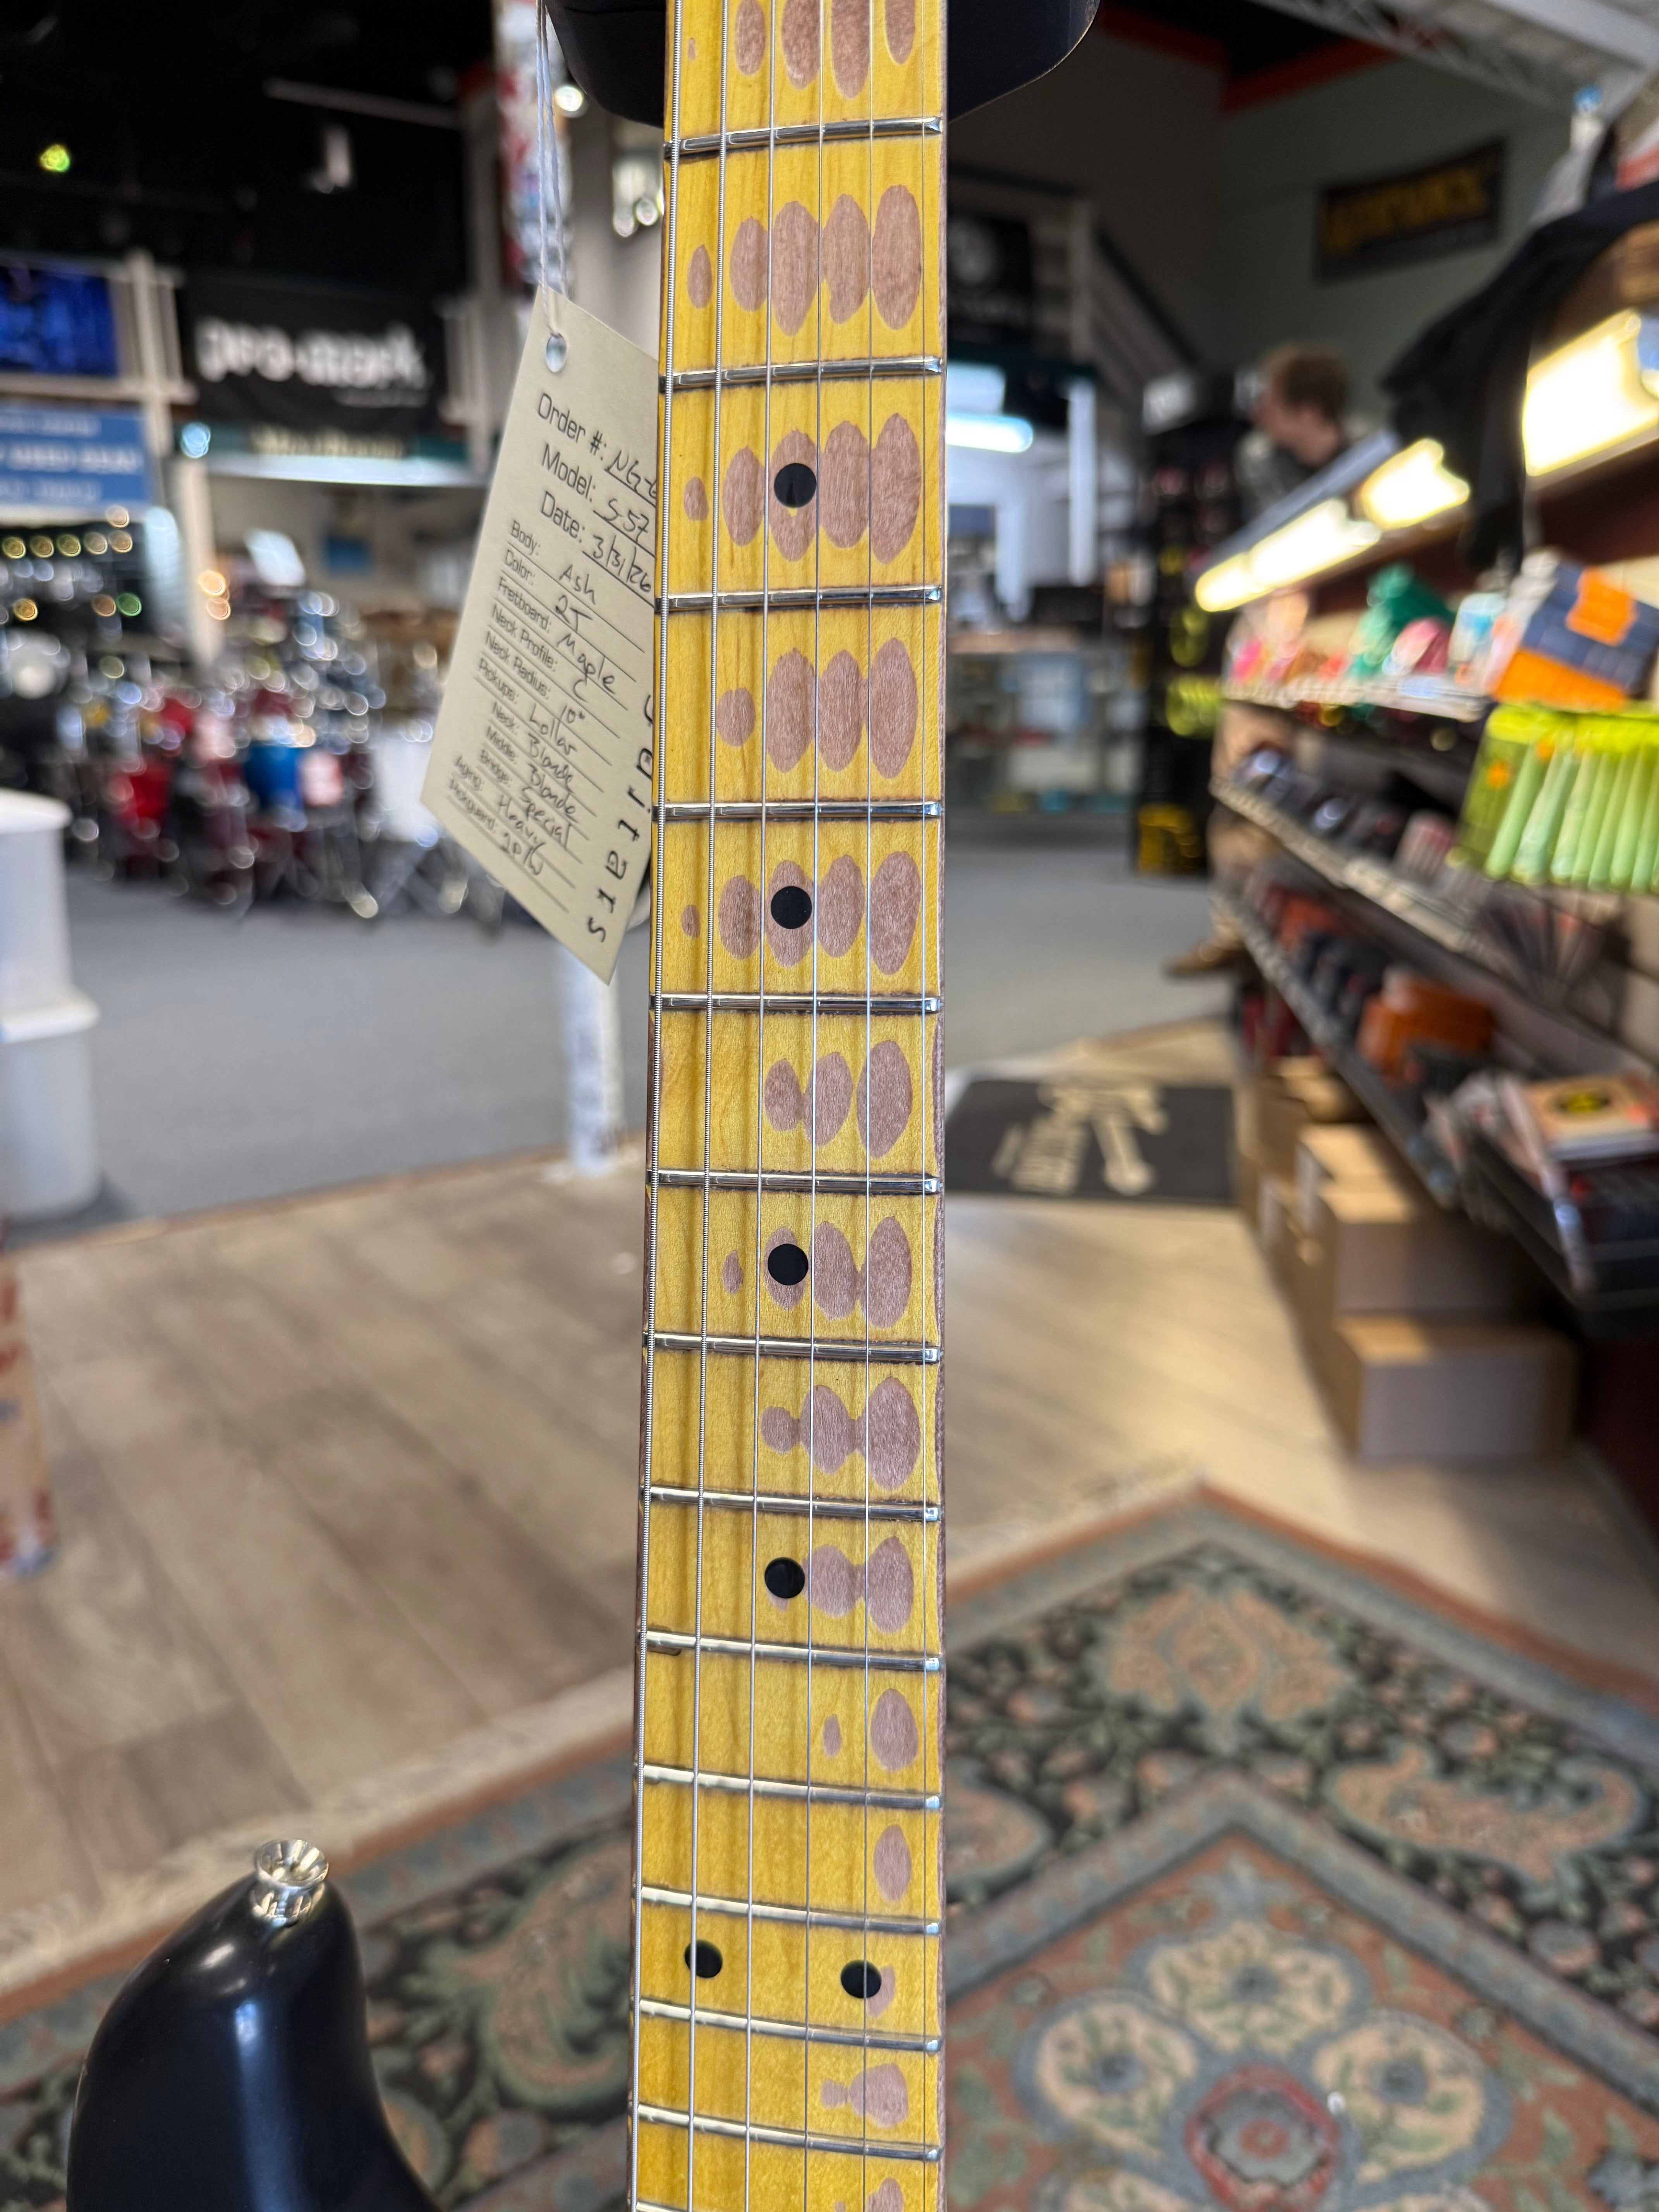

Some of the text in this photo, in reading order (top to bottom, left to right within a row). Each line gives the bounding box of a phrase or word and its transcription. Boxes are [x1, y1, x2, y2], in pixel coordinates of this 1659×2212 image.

[538, 393, 586, 443] Order
[590, 431, 607, 461] #:
[542, 443, 596, 503] Model:
[541, 491, 585, 543] Date:
[504, 549, 536, 586] Color:
[510, 520, 596, 605] Body: Ash
[485, 630, 510, 664] Neck
[513, 656, 551, 700] Radius:
[492, 603, 517, 637] Neck
[519, 629, 558, 672] Profile:
[498, 576, 617, 695] Fretboard: Maple
[478, 658, 519, 705] Pickups:
[493, 701, 519, 735] Neck:
